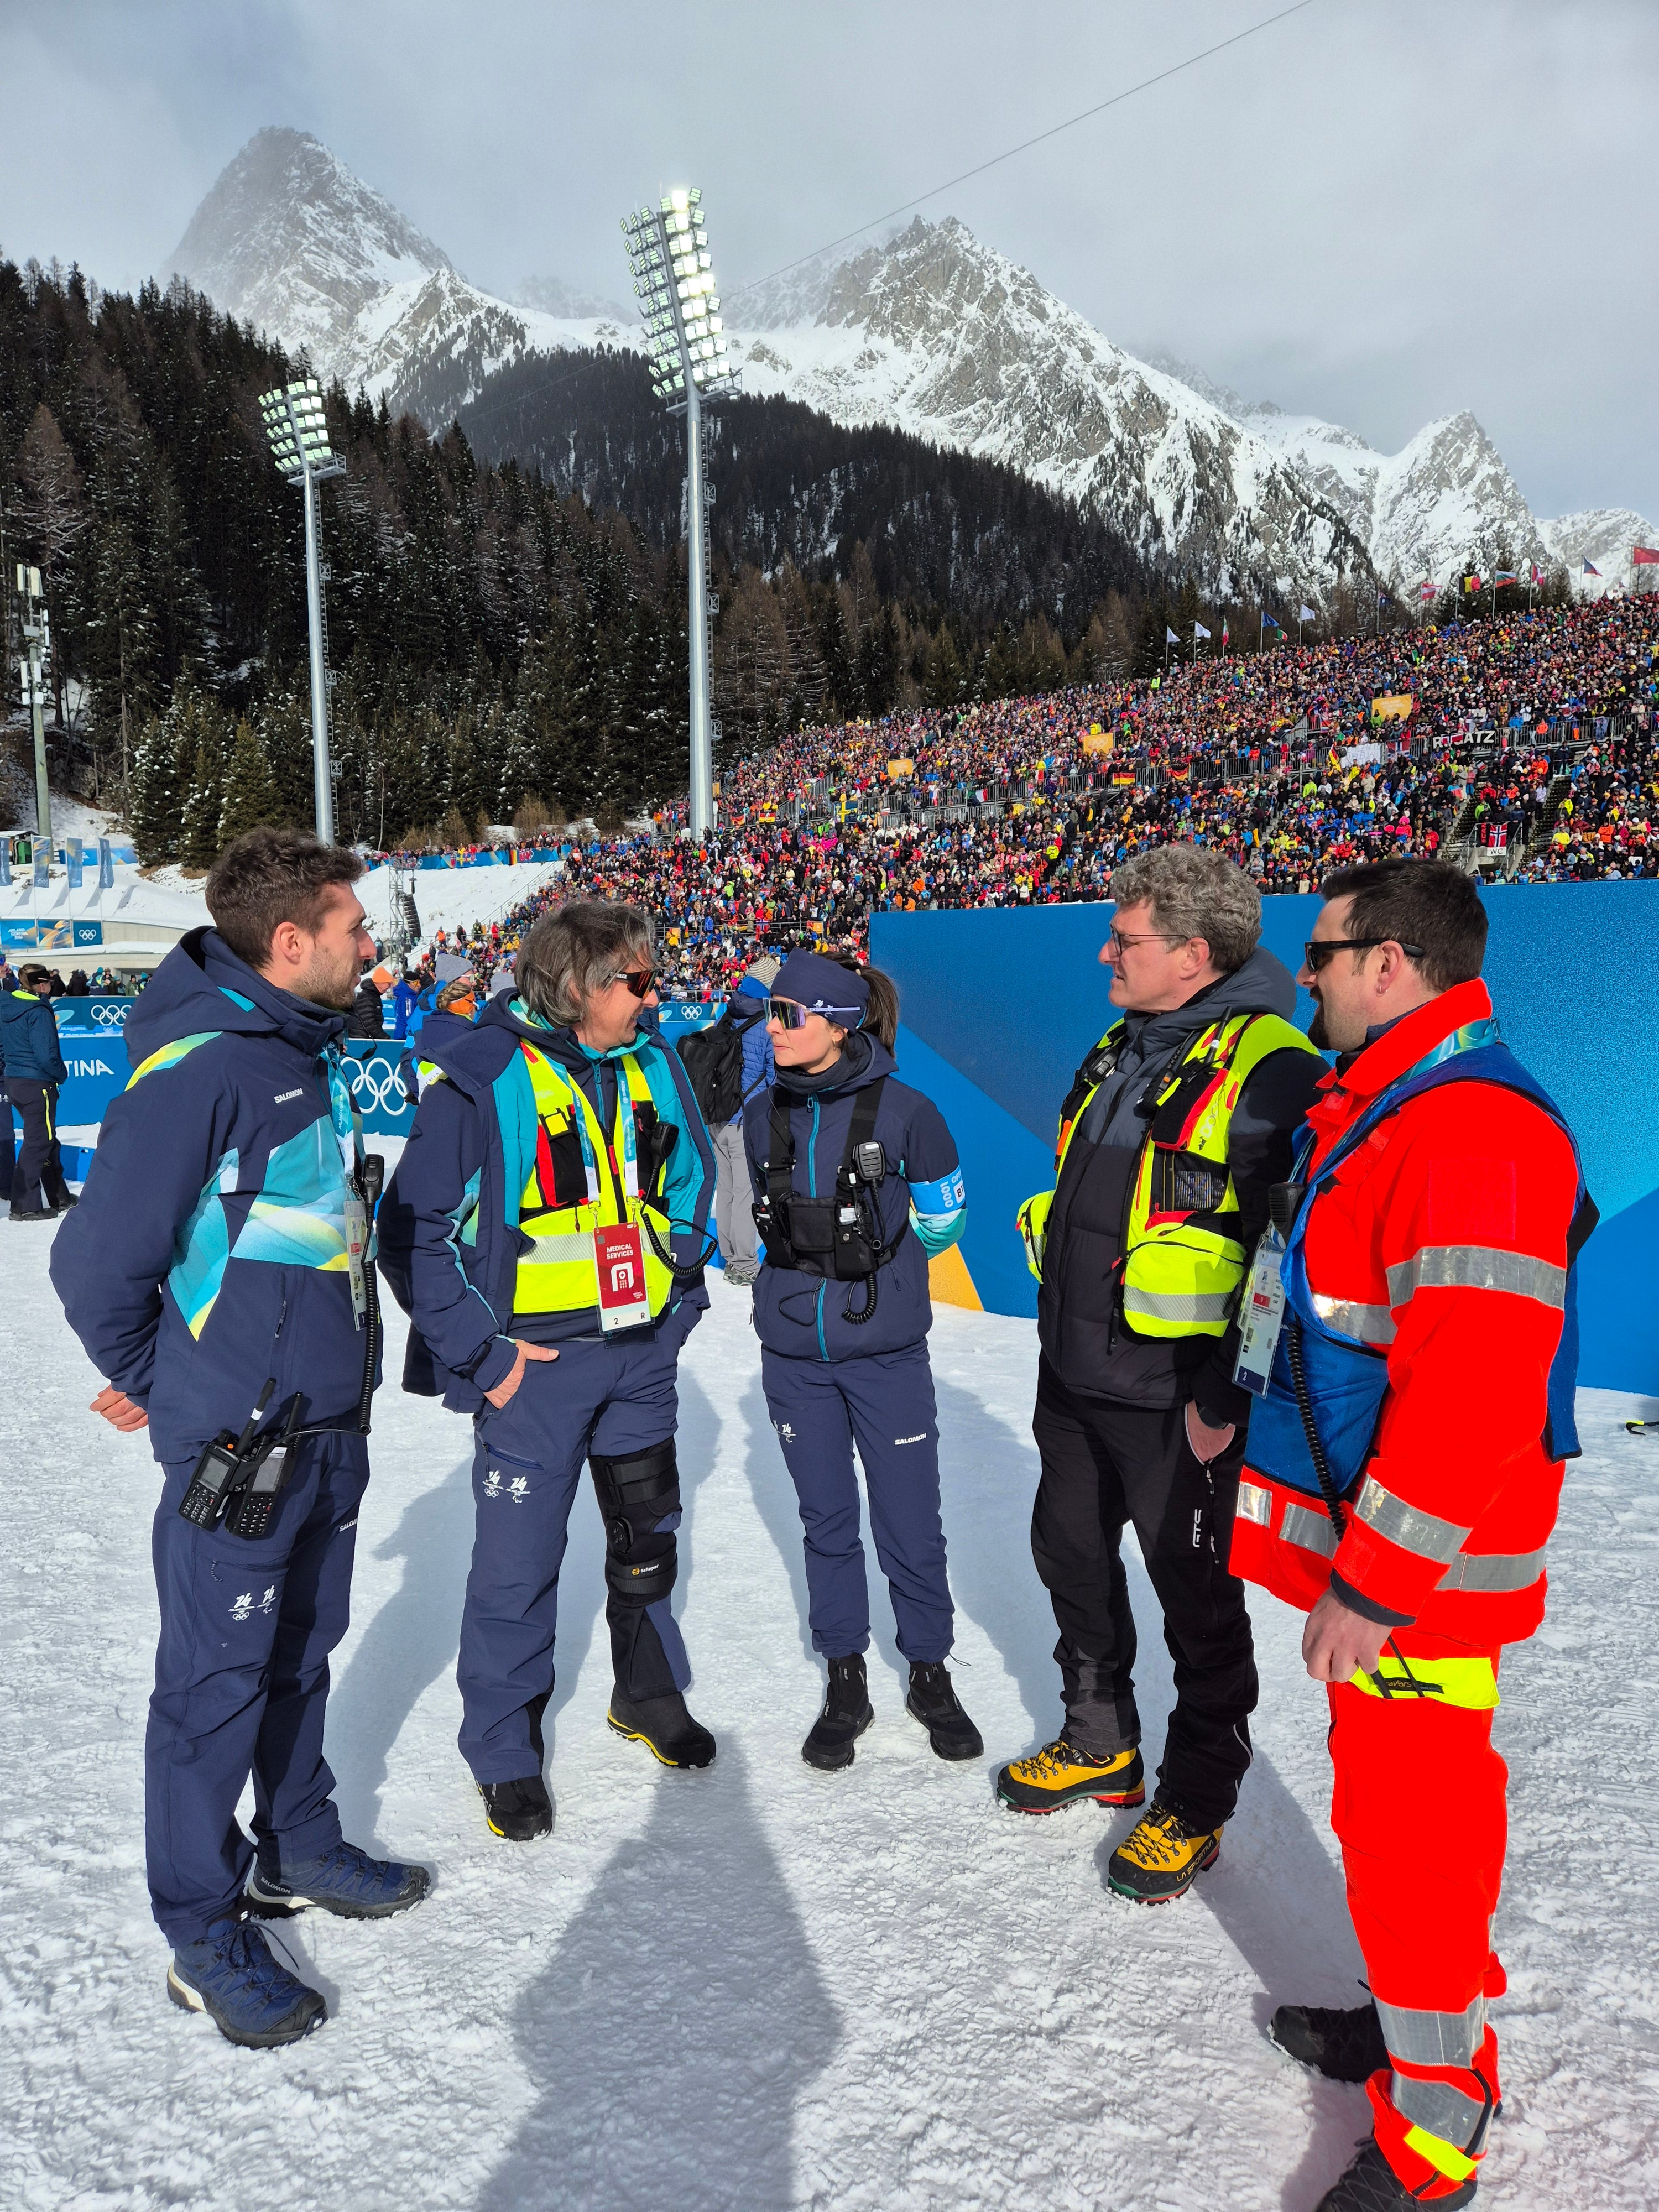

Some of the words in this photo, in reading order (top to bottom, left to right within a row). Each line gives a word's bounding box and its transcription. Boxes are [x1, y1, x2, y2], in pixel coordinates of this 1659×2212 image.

[274, 1088, 304, 1103] SALOMON
[606, 1243, 632, 1253] MEDICAL
[607, 1250, 634, 1260] SERVICES
[1243, 1371, 1248, 1381] 2
[894, 1433, 926, 1445] SALOMON
[640, 1564, 659, 1573] Schaper
[1176, 1872, 1187, 1881] LA
[1187, 1839, 1213, 1875] SPORTIVA
[260, 1876, 291, 1893] SALOMON
